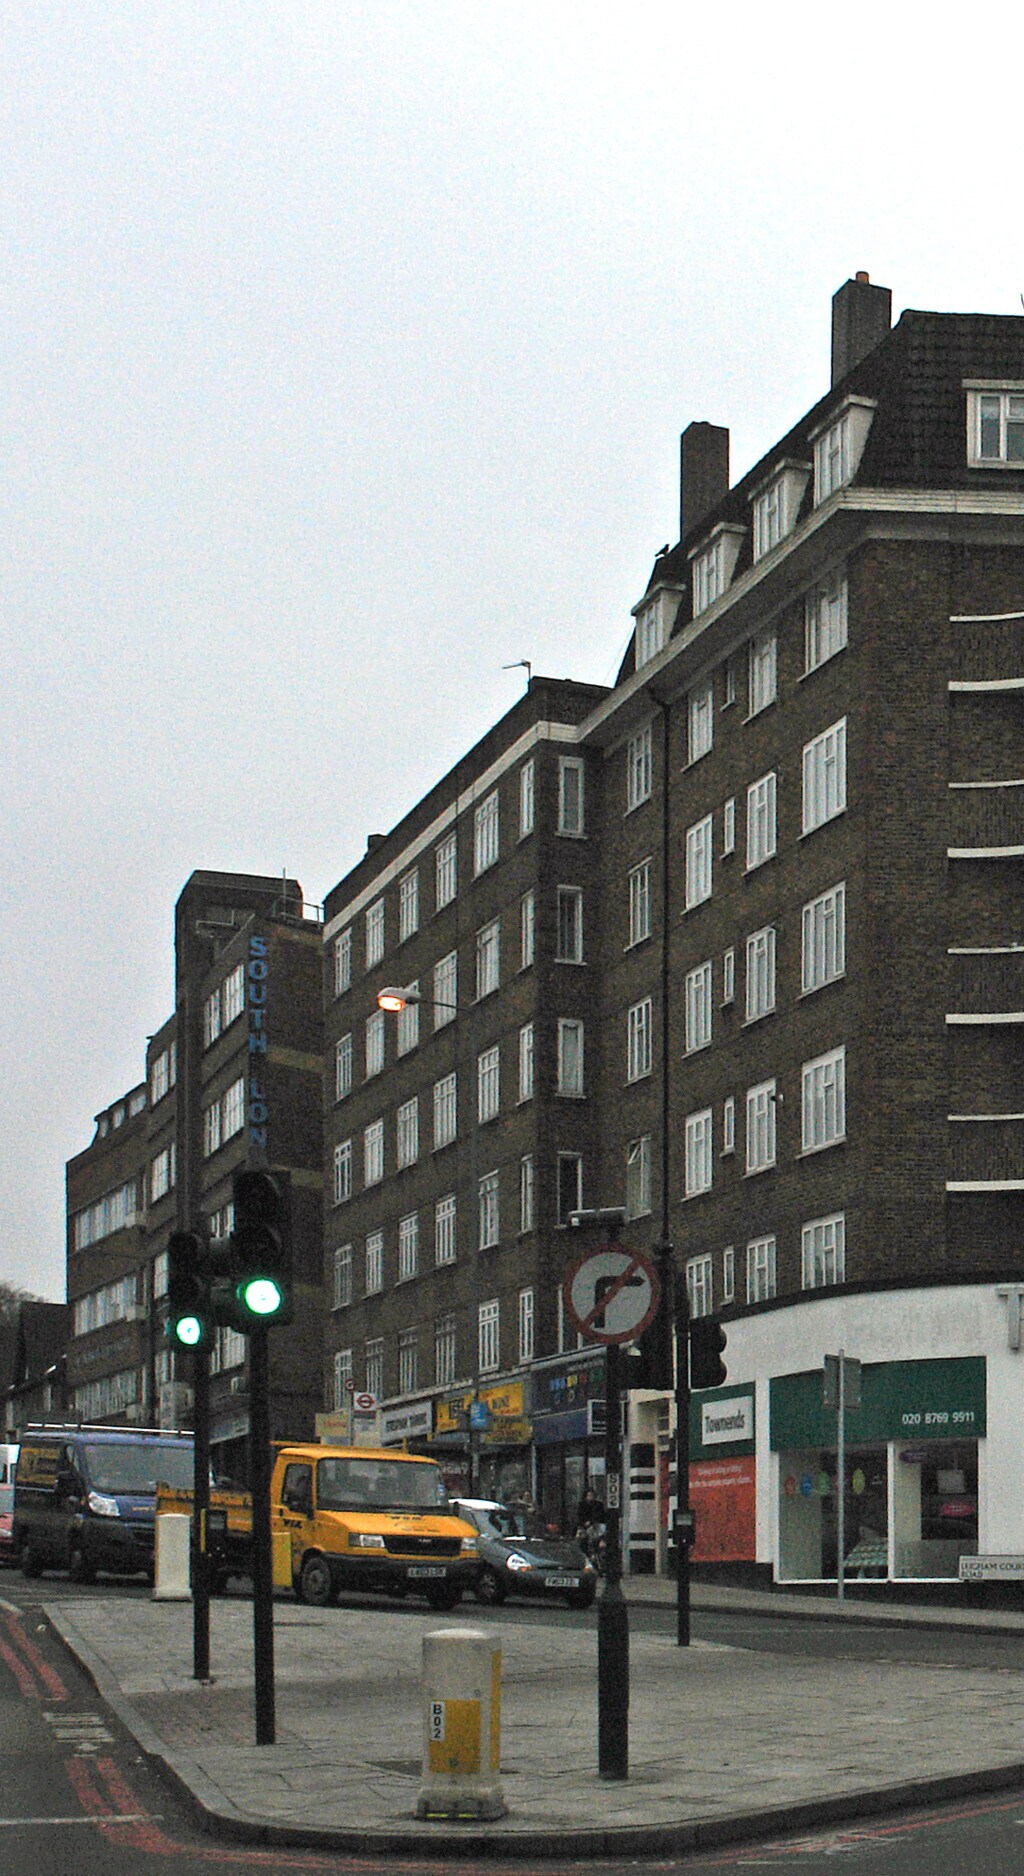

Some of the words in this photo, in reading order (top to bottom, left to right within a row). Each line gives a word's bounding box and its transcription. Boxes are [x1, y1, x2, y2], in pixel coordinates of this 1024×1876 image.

[248, 937, 268, 1053] SOUTH
[705, 1409, 746, 1433] Townends
[902, 1413, 921, 1425] 020
[925, 1412, 949, 1424] 8769
[952, 1411, 975, 1423] 9911
[961, 1562, 997, 1570] LEIGHAM
[961, 1570, 983, 1578] ROAD
[432, 1704, 442, 1739] B02
